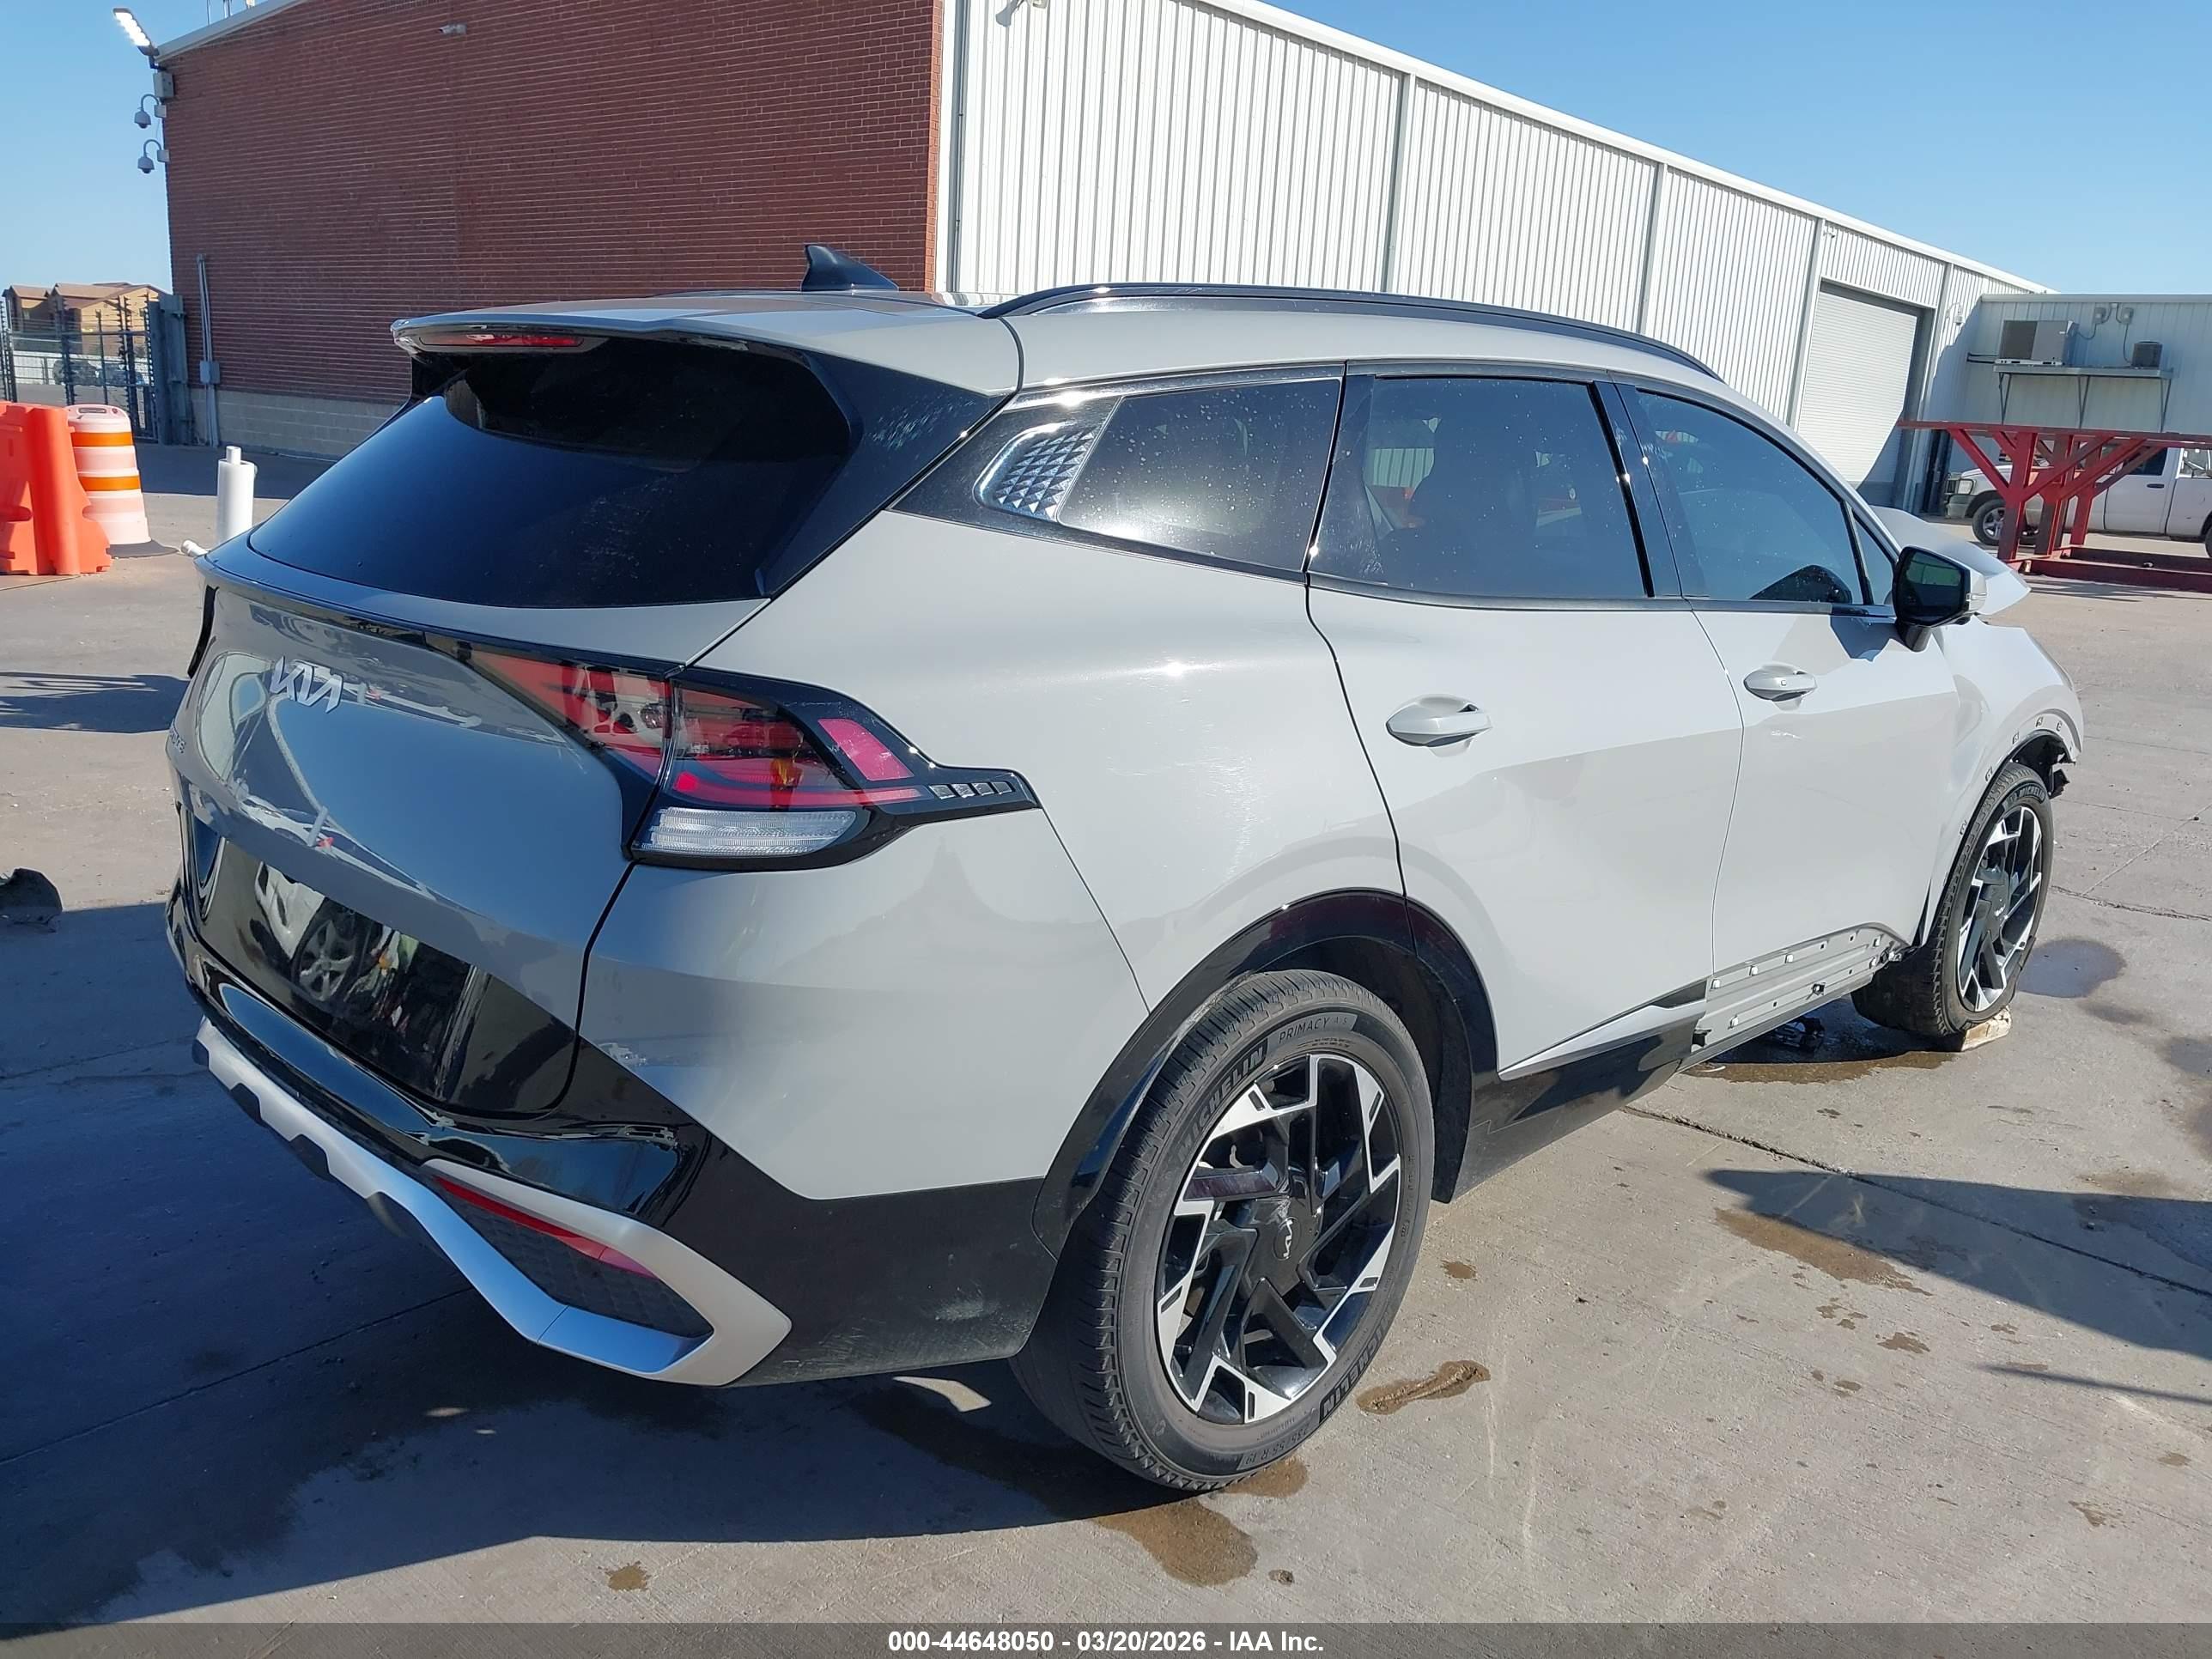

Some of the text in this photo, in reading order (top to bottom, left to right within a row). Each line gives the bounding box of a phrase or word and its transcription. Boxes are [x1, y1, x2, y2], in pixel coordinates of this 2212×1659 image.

[269, 655, 343, 714] KIA
[1279, 1017, 1330, 1044] PRIMACY
[1177, 1045, 1263, 1163] MICHELIN
